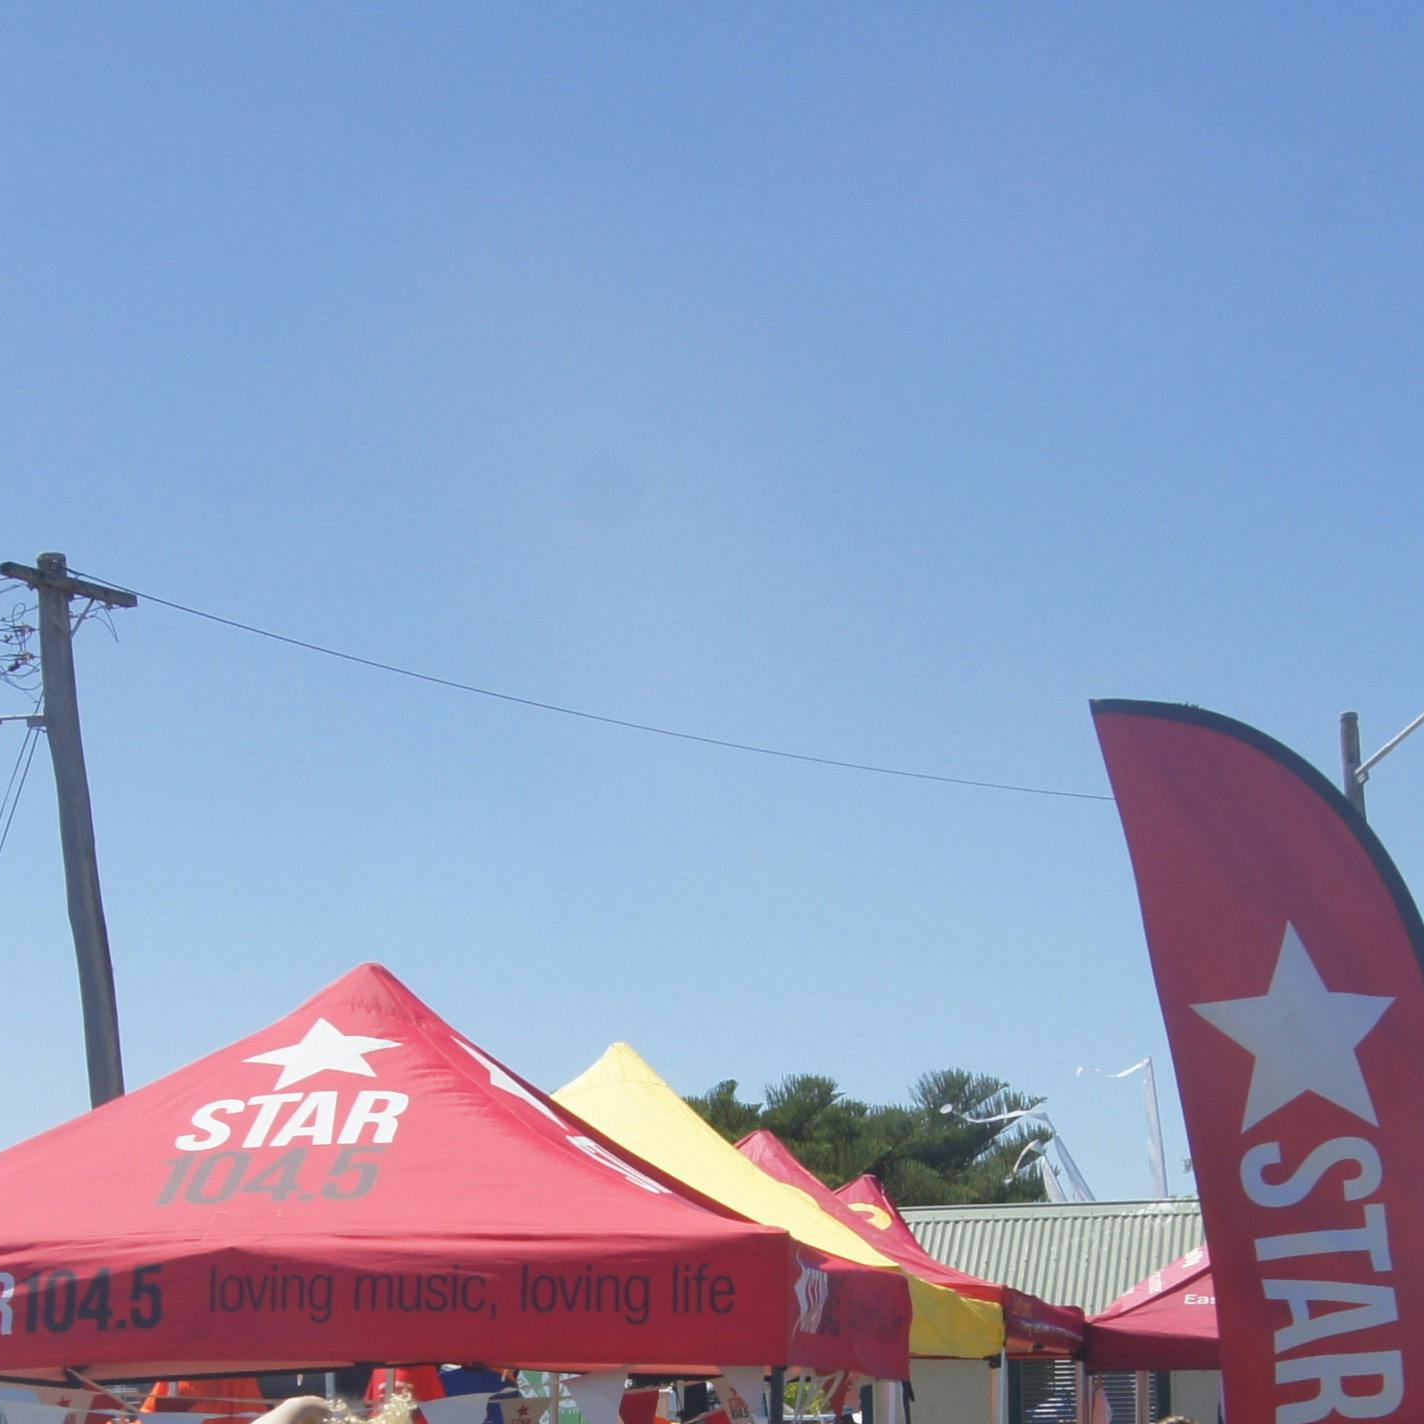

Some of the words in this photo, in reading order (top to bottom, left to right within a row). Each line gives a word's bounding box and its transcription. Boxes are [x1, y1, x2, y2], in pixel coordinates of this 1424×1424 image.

[175, 1090, 409, 1151] STAR
[156, 1146, 385, 1207] 104.5
[210, 1264, 332, 1323] loving
[521, 1264, 651, 1324] loving
[672, 1264, 736, 1313] life
